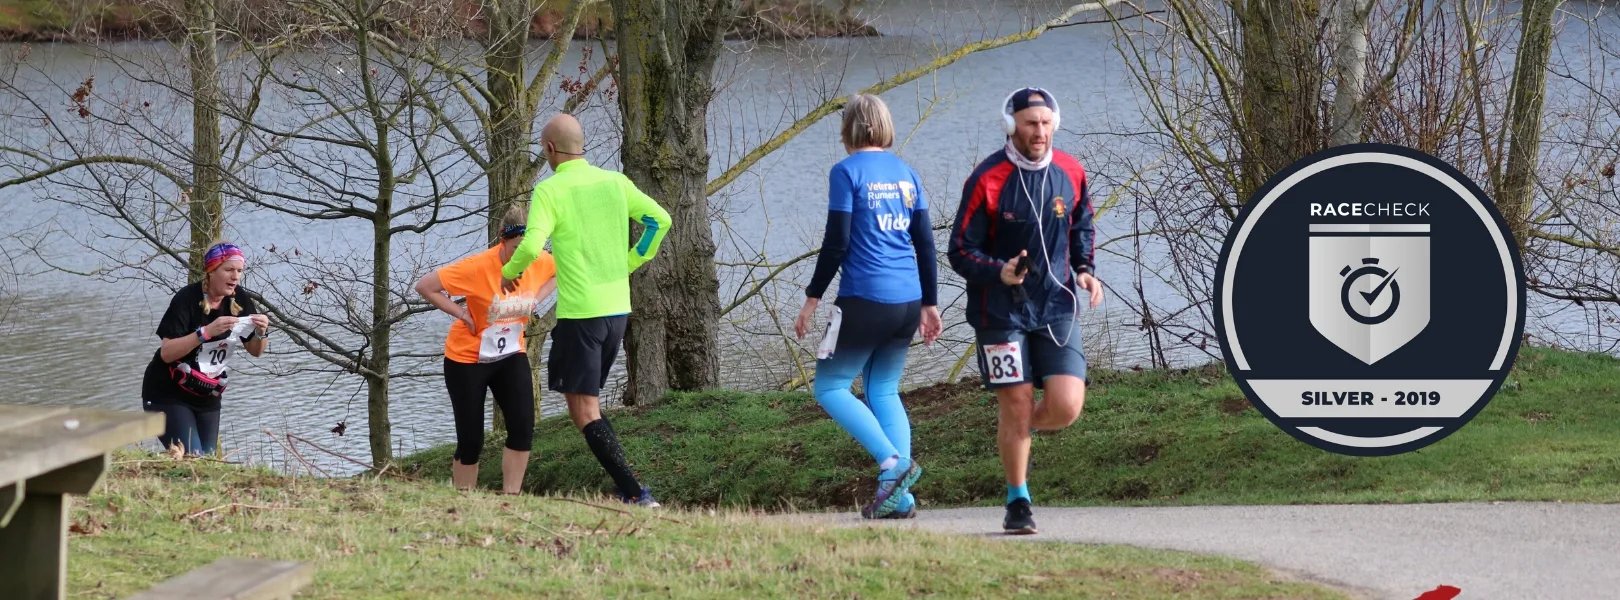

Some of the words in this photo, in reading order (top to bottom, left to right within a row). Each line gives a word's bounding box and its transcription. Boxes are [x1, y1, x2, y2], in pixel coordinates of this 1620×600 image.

[867, 183, 898, 191] Veteran
[867, 192, 900, 200] Runners
[868, 200, 881, 209] UK
[497, 337, 506, 354] 9
[209, 349, 227, 366] 20
[992, 354, 1018, 379] 83
